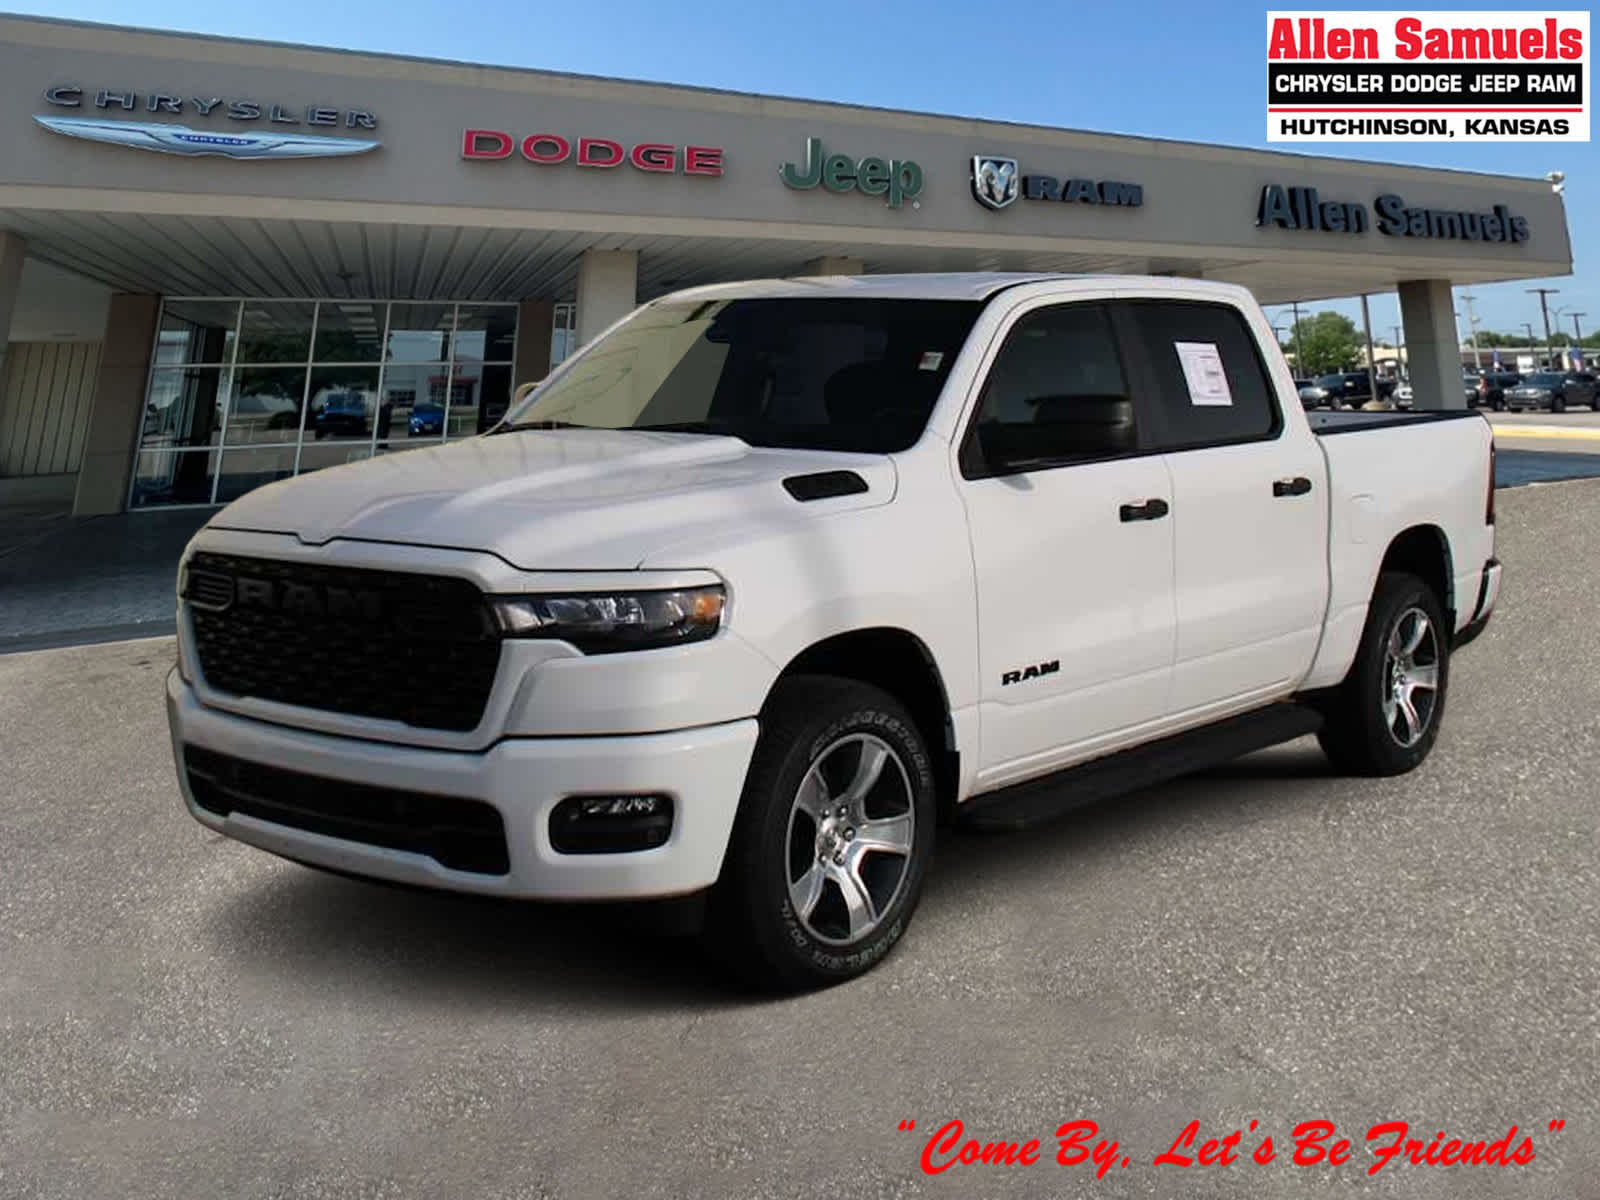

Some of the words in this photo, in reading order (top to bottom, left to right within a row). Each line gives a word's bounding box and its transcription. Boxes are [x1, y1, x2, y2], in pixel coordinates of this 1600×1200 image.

[44, 86, 378, 129] CHRYSLER
[460, 128, 725, 177] DODGE
[778, 136, 924, 209] Jeep
[1022, 175, 1144, 207] RAM
[1255, 183, 1369, 233] Allen
[1374, 194, 1531, 243] Samuels
[1002, 660, 1060, 686] RAM
